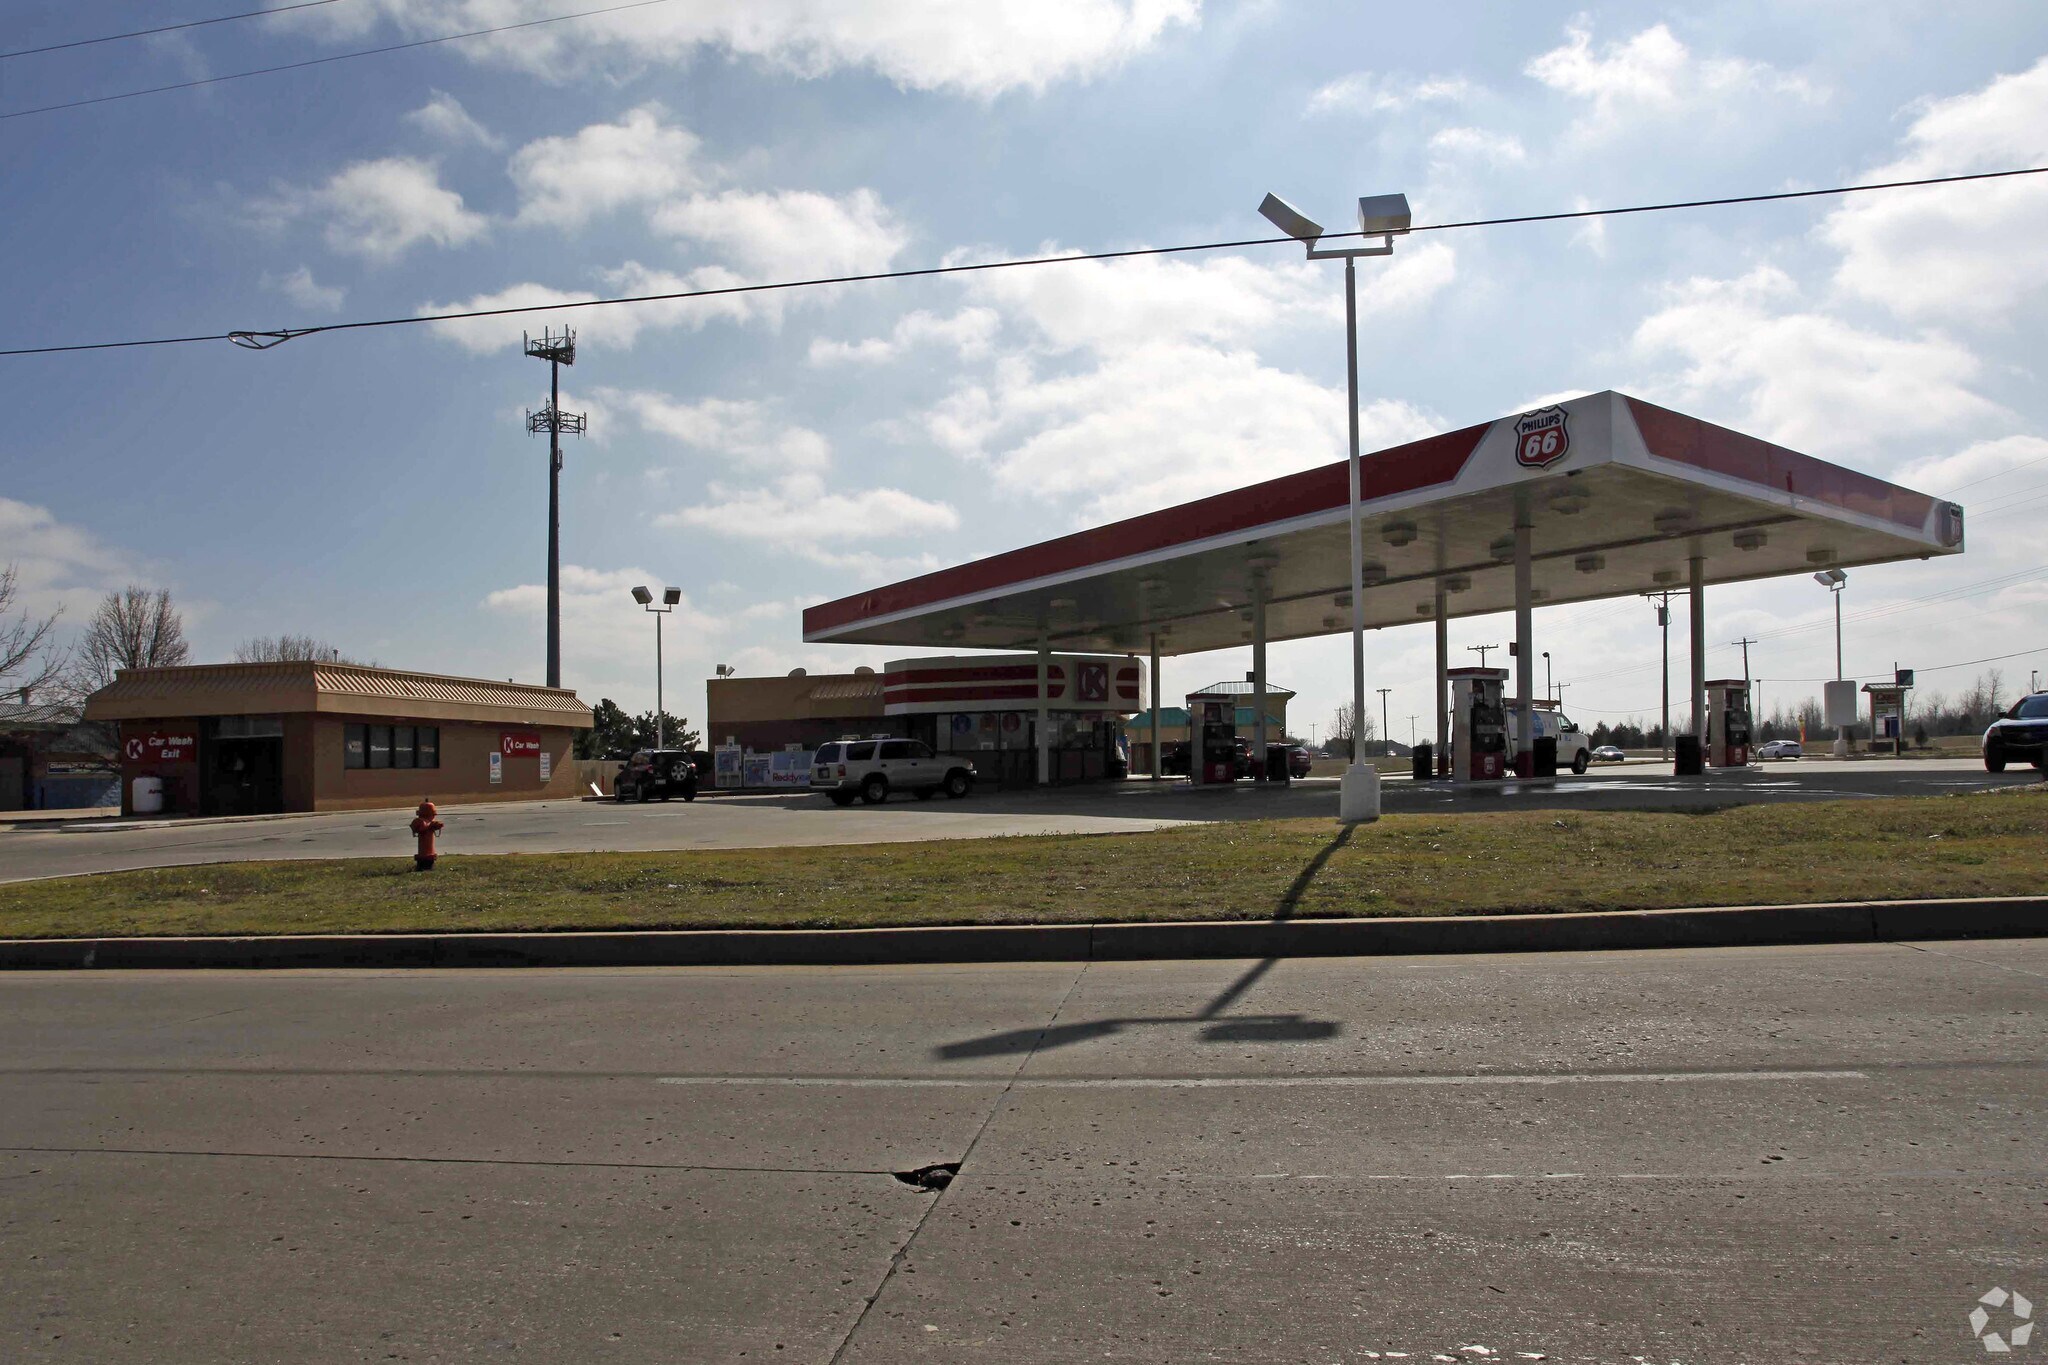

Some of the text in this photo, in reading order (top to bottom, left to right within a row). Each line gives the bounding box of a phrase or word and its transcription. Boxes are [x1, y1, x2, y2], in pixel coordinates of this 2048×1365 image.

[1521, 413, 1560, 433] PHILLIPS
[1525, 430, 1559, 458] 66
[1082, 666, 1106, 699] K
[126, 739, 143, 759] K
[148, 736, 193, 746] Car Wash
[503, 737, 514, 753] K
[526, 742, 540, 750] Wash
[161, 749, 180, 759] Exit
